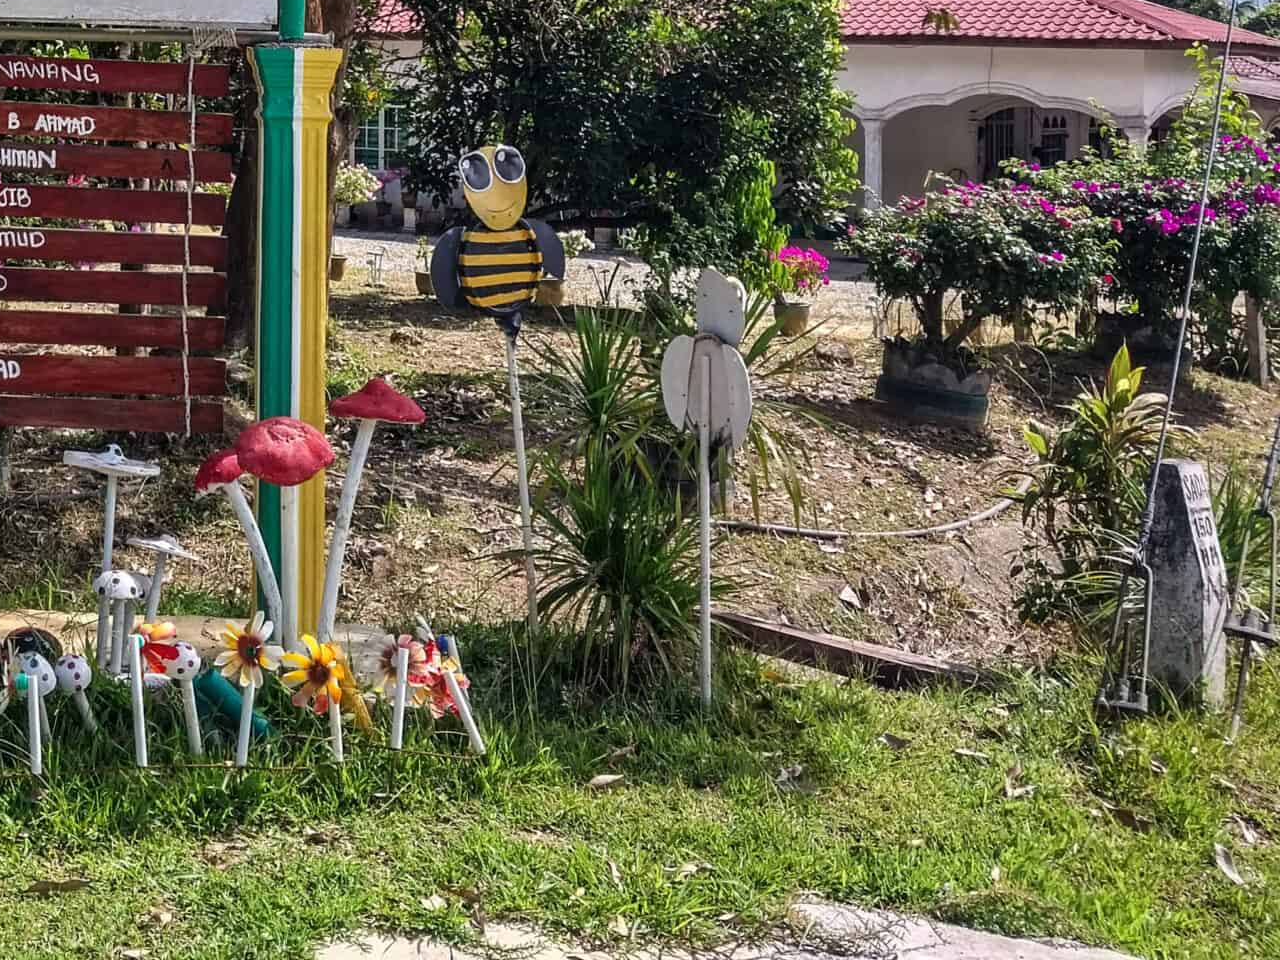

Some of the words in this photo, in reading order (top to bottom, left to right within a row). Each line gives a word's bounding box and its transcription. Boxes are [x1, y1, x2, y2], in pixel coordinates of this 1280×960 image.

[8, 112, 20, 129] B
[34, 113, 96, 135] AHMAD
[1193, 516, 1214, 539] 150
